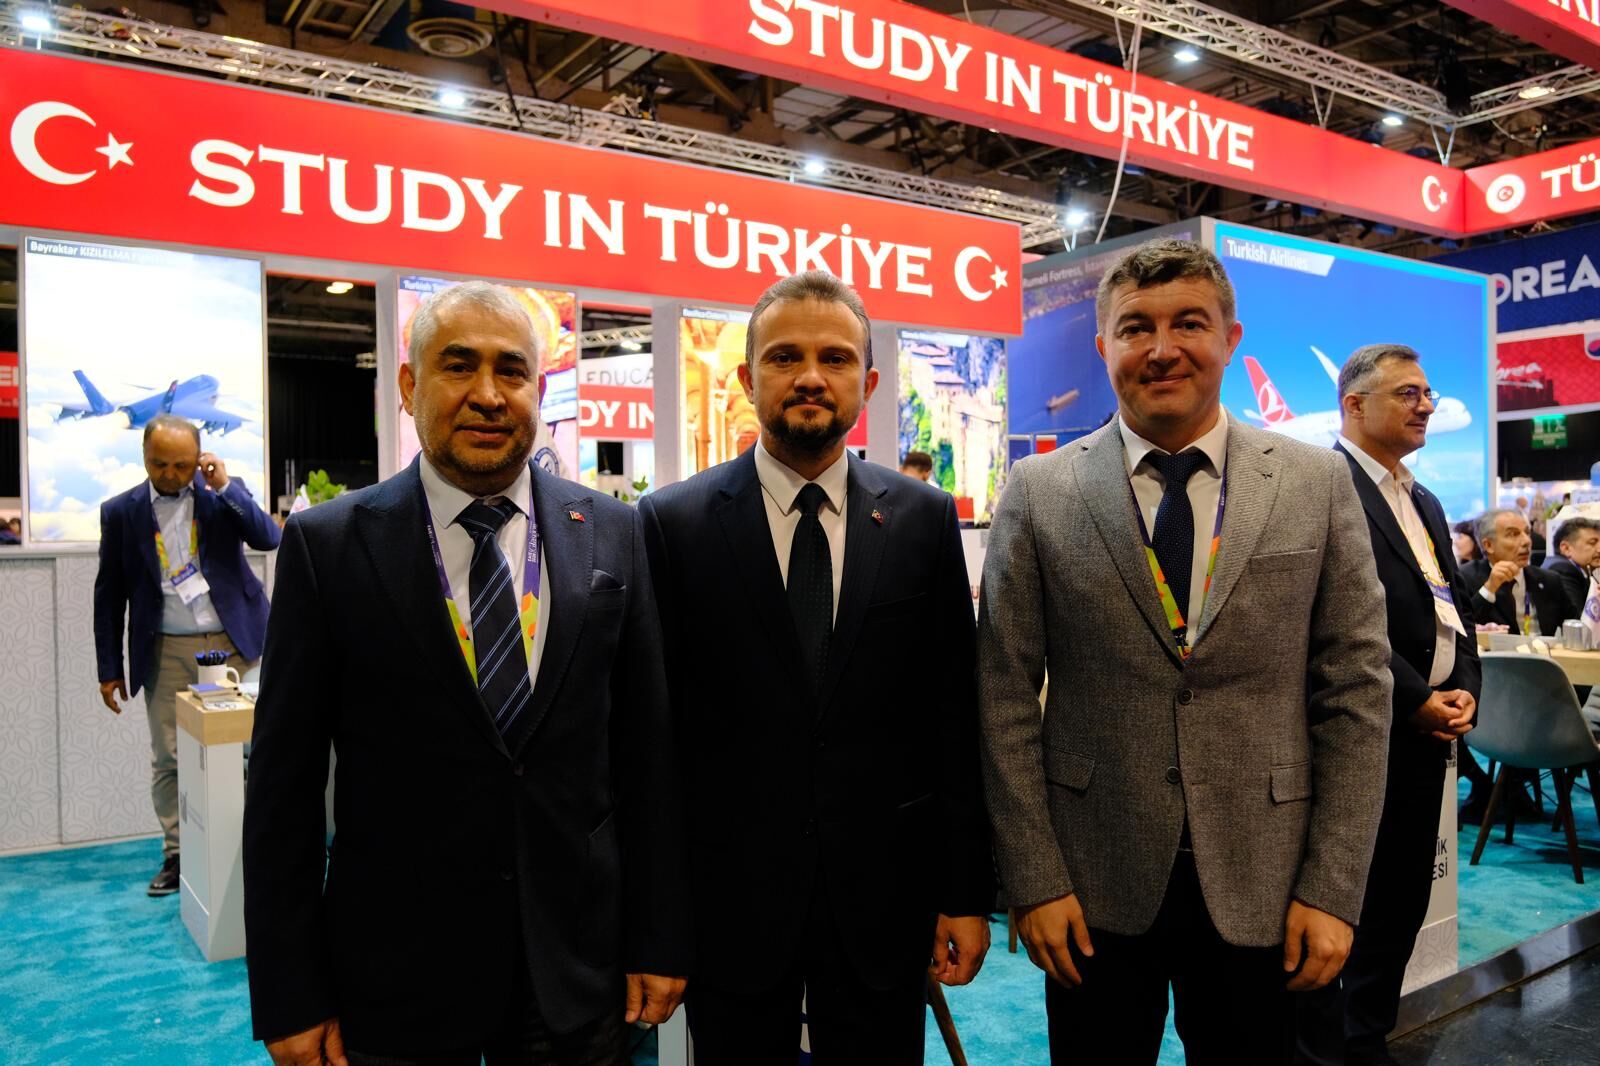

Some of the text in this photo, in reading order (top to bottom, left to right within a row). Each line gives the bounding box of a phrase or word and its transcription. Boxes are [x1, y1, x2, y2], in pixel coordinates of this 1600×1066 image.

[747, 0, 1254, 171] STUDY IN TÜRKİYE
[188, 138, 933, 298] STUDY IN TÜRKİYE
[30, 241, 78, 255] Bayraktar
[1226, 240, 1309, 270] Turkish Airlines
[578, 400, 622, 429] DY
